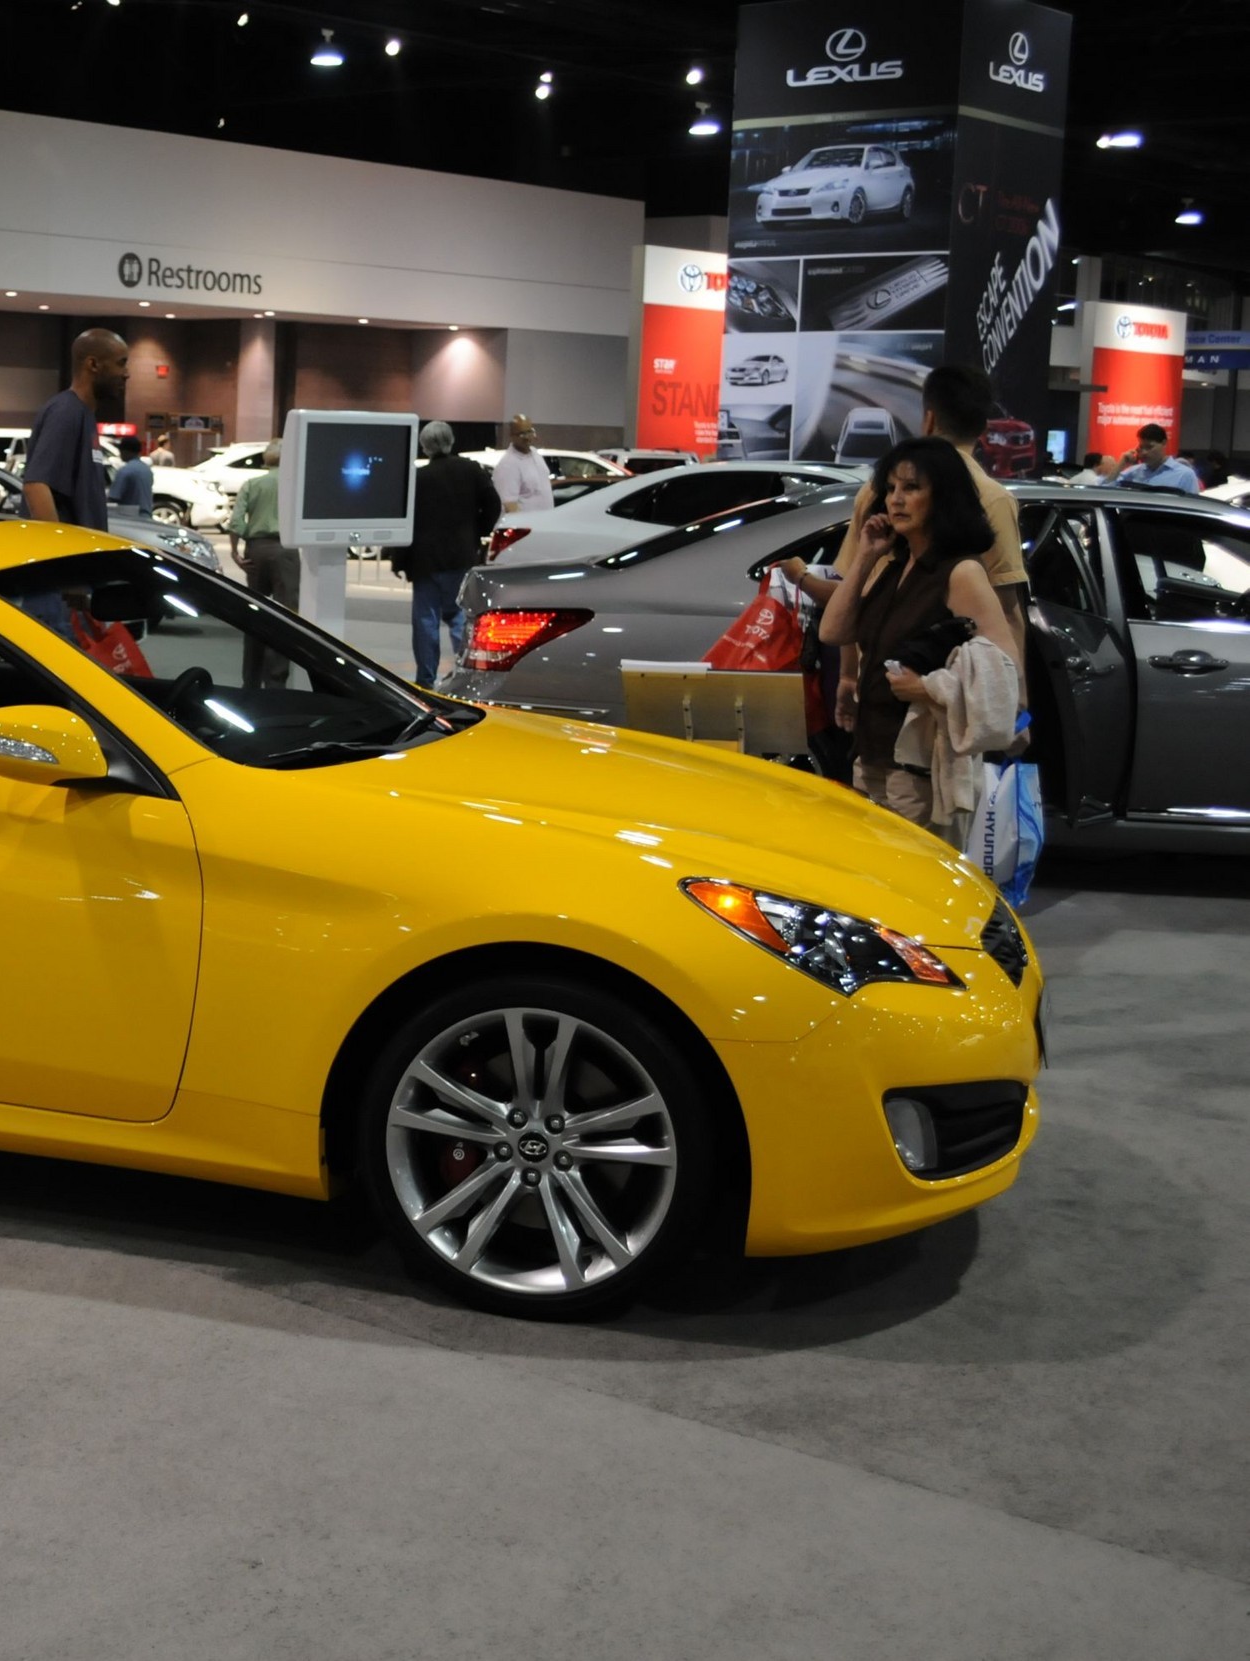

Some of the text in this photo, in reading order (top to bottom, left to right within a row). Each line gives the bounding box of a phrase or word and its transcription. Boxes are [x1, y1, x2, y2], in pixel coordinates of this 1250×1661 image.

[786, 60, 903, 87] LEXUS
[989, 61, 1044, 92] LEXUS
[147, 257, 262, 295] Restrooms
[983, 198, 1059, 375] CONVENTION
[976, 251, 1006, 341] ESCAPE
[1208, 334, 1241, 343] Center
[983, 811, 995, 880] HYUNDA
